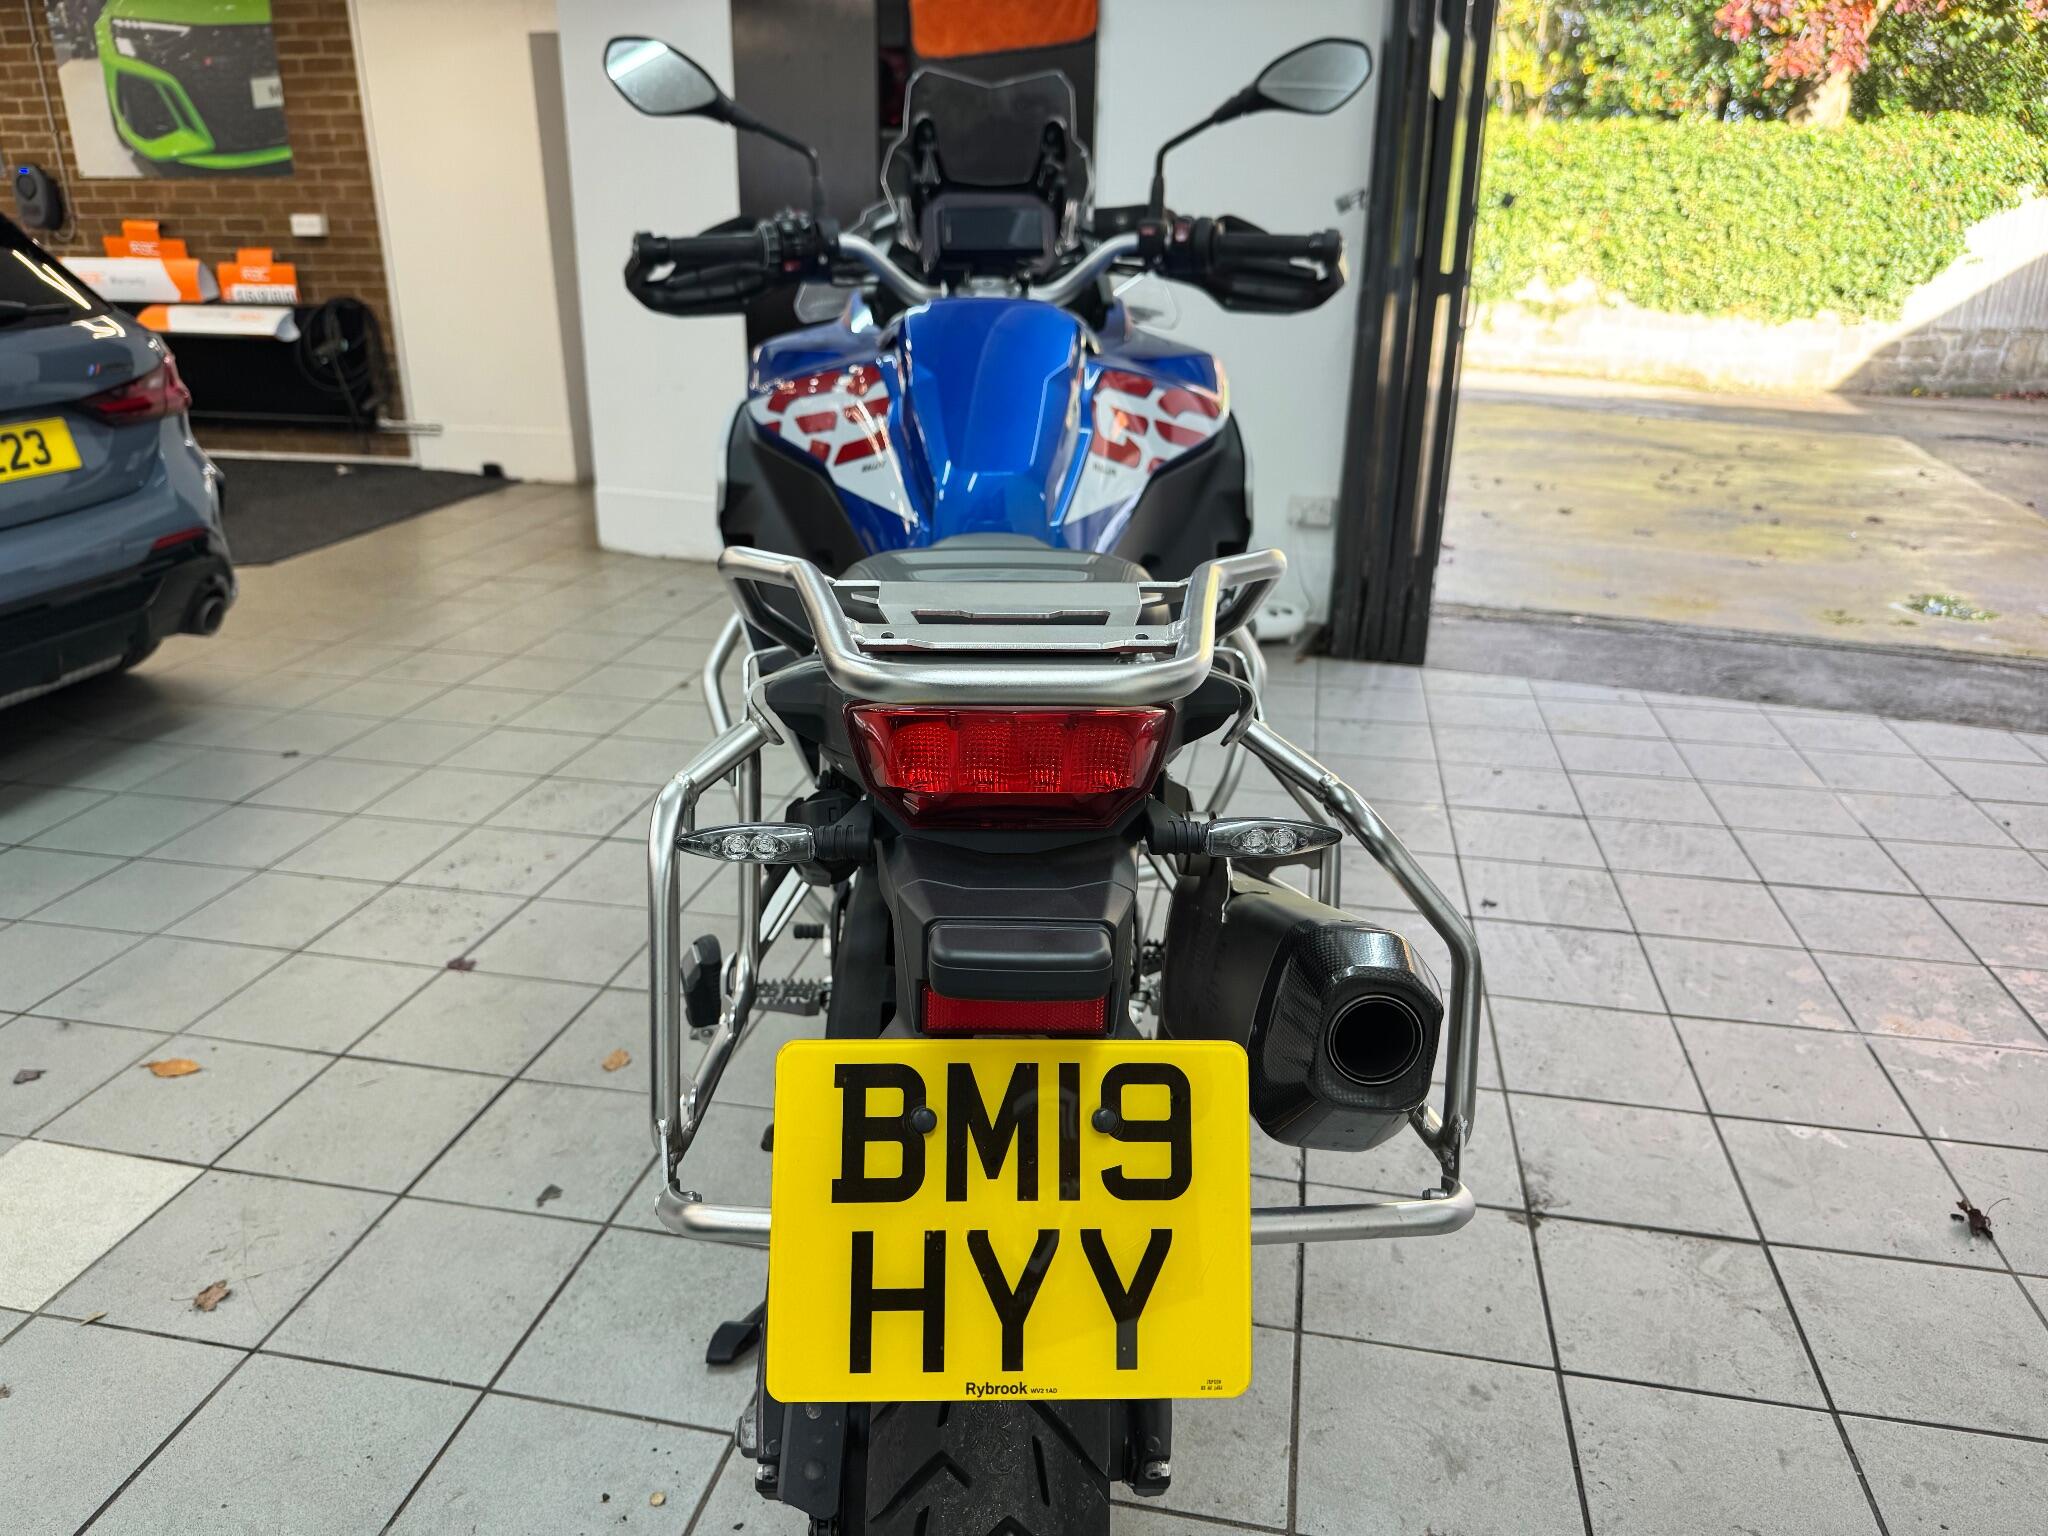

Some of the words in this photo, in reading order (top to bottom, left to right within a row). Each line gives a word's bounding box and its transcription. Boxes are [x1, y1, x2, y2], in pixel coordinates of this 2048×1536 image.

[0, 429, 52, 472] 23
[831, 1063, 1192, 1203] BM19
[849, 1229, 1173, 1373] HYY
[966, 1382, 1027, 1398] Rybrook
